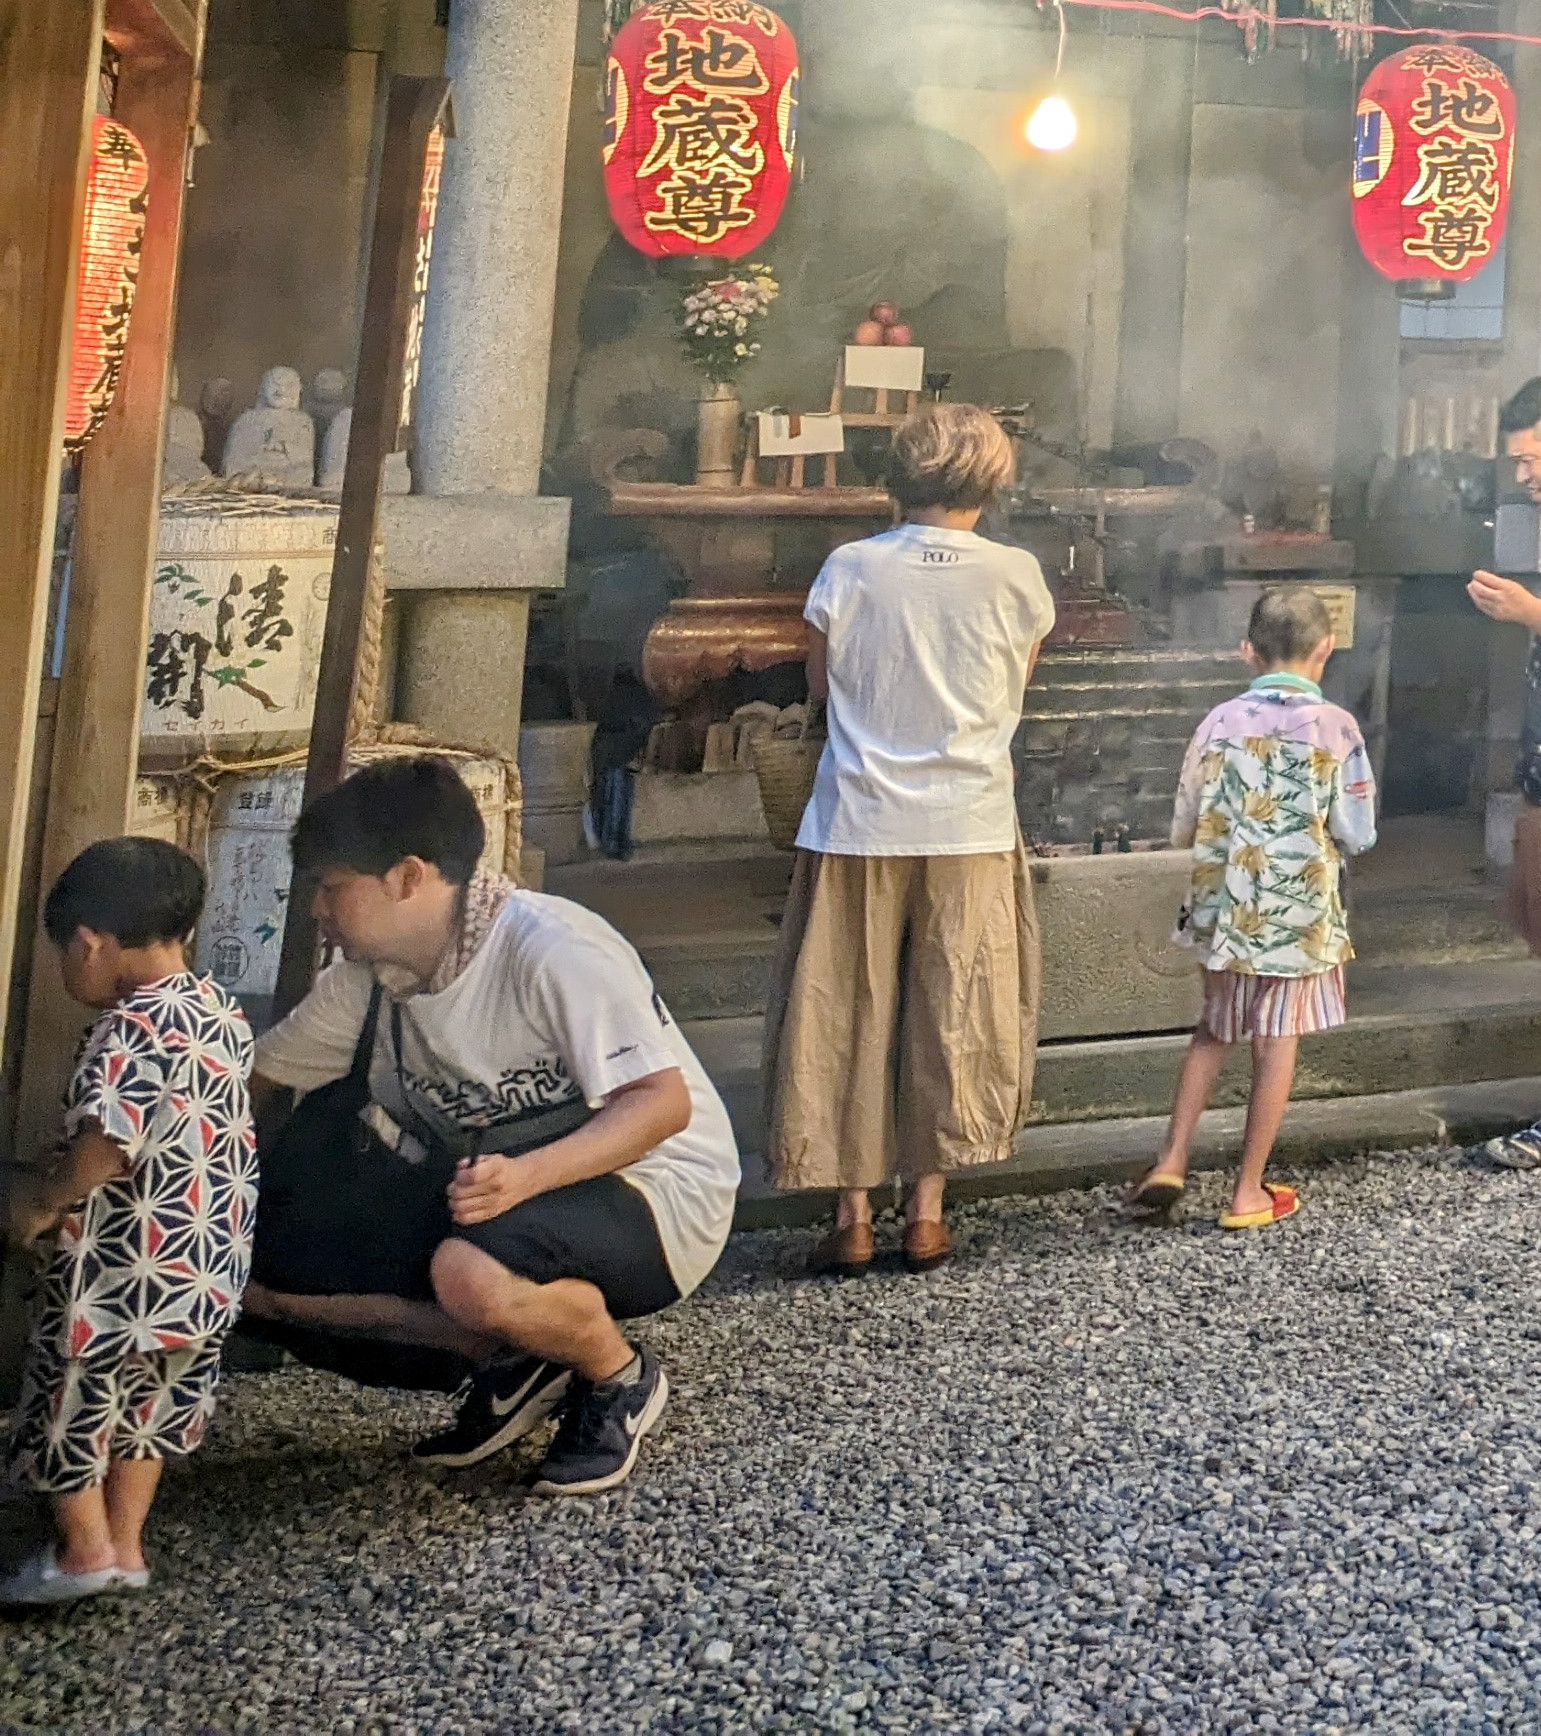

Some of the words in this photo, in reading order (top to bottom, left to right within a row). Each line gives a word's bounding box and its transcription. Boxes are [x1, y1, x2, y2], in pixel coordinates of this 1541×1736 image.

[636, 26, 770, 244] 地蔵尊
[1400, 76, 1506, 271] 地蔵尊
[921, 550, 960, 564] POLO
